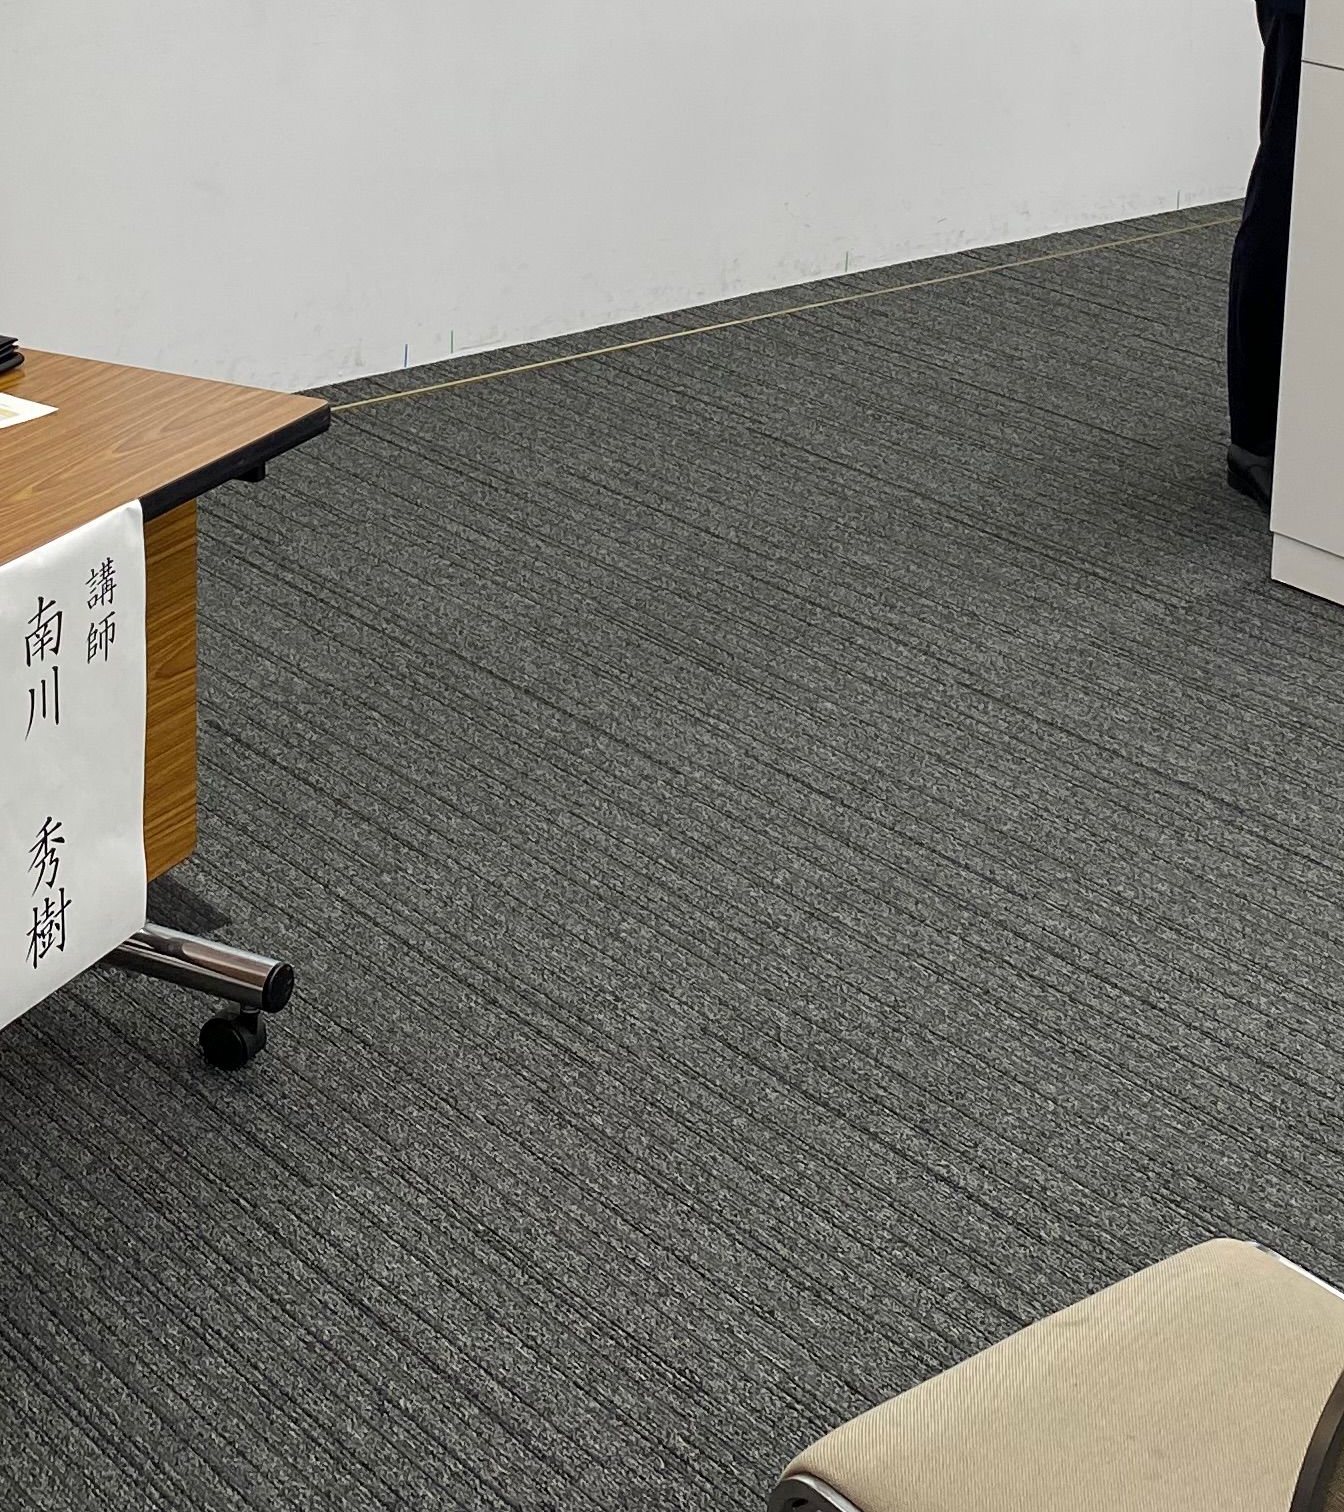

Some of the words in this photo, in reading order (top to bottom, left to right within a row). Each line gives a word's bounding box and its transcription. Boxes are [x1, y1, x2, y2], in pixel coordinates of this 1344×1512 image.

[24, 595, 64, 742] 南川
[84, 555, 118, 665] 講師
[24, 815, 72, 970] 秀樹
